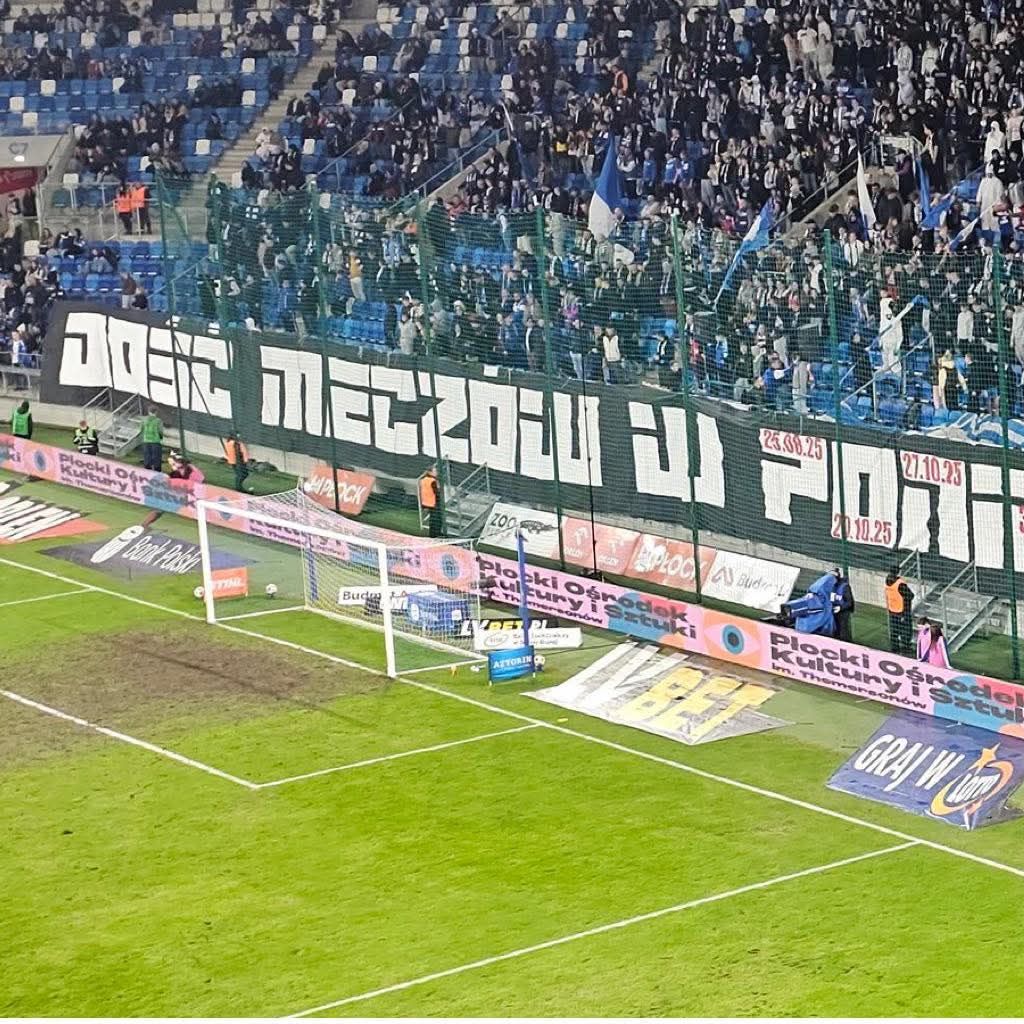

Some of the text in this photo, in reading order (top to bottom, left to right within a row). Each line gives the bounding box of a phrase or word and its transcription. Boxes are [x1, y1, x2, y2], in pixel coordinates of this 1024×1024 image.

[763, 430, 823, 461] 25.08.25
[903, 452, 962, 486] 27.10.25
[503, 593, 603, 624] Thmersonów
[771, 646, 902, 694] Kultury
[854, 734, 934, 791] GRAJ
[915, 749, 965, 790] W
